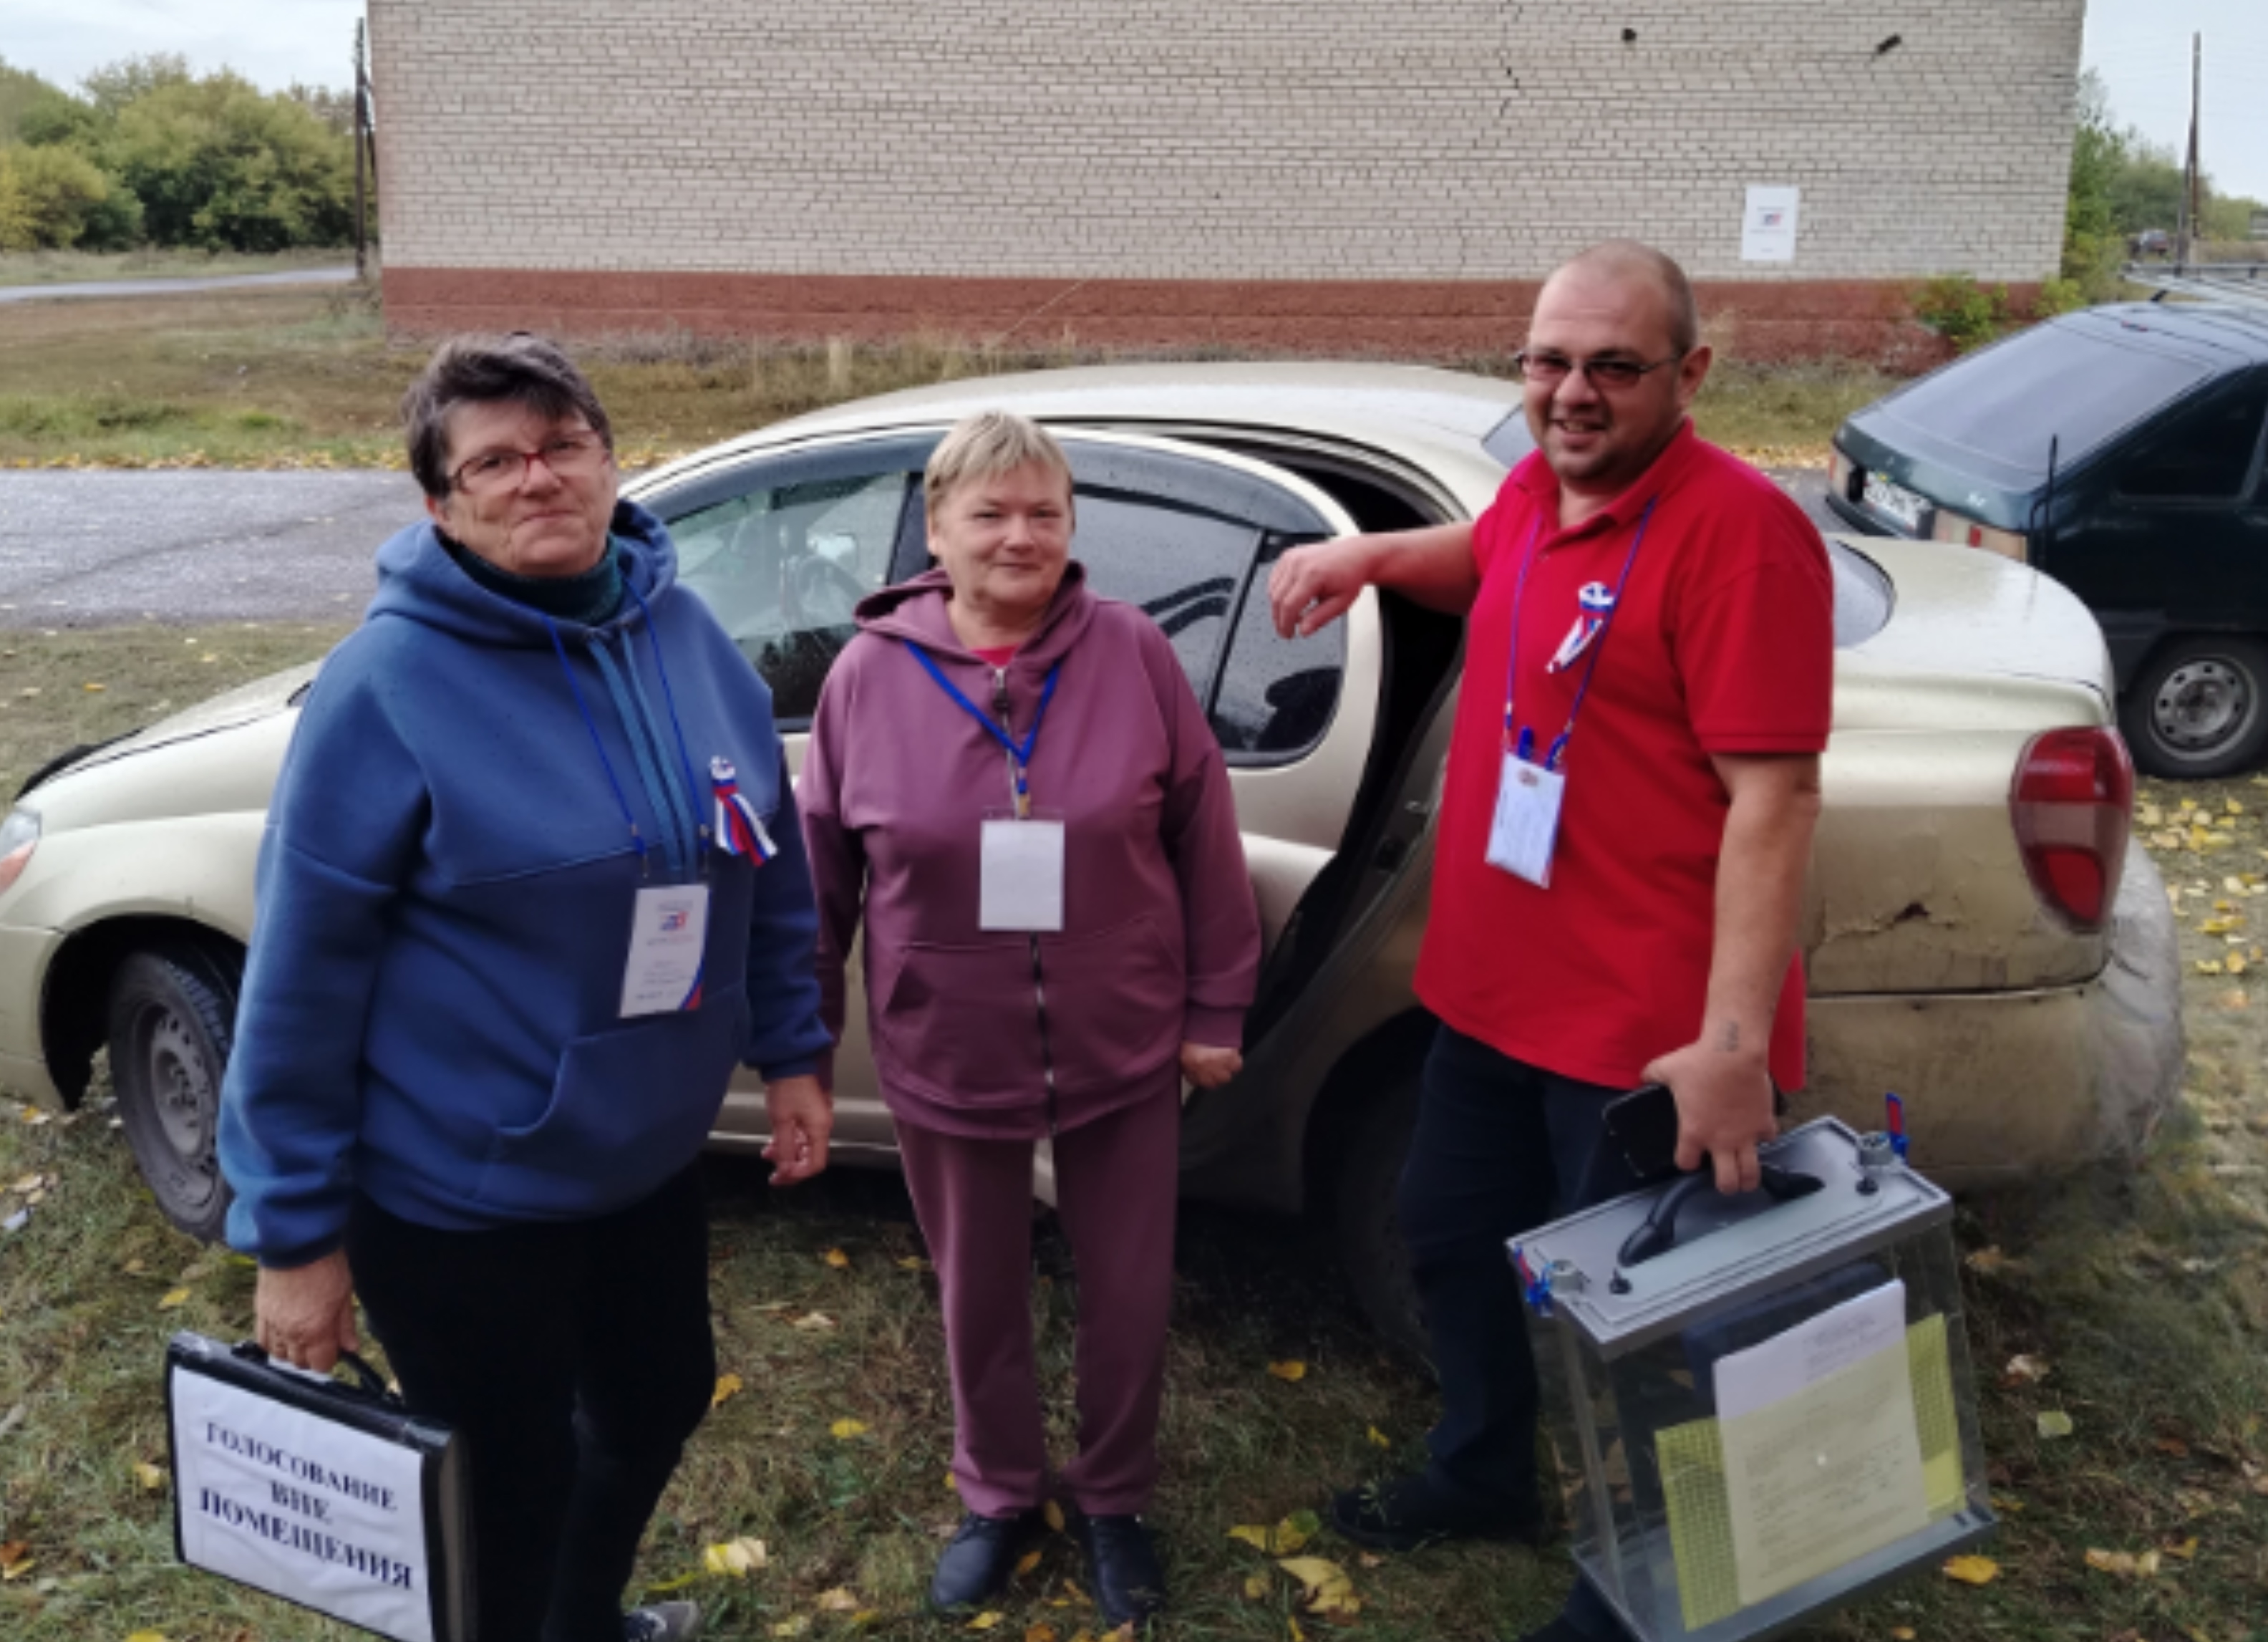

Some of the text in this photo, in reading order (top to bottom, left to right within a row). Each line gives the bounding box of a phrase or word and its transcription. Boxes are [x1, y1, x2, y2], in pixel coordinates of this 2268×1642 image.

[207, 1423, 397, 1511] ГОЛОСОВАНИЕ
[271, 1480, 331, 1523] ВНЕ
[201, 1487, 412, 1589] ПОМЕЩЕНИЯ
